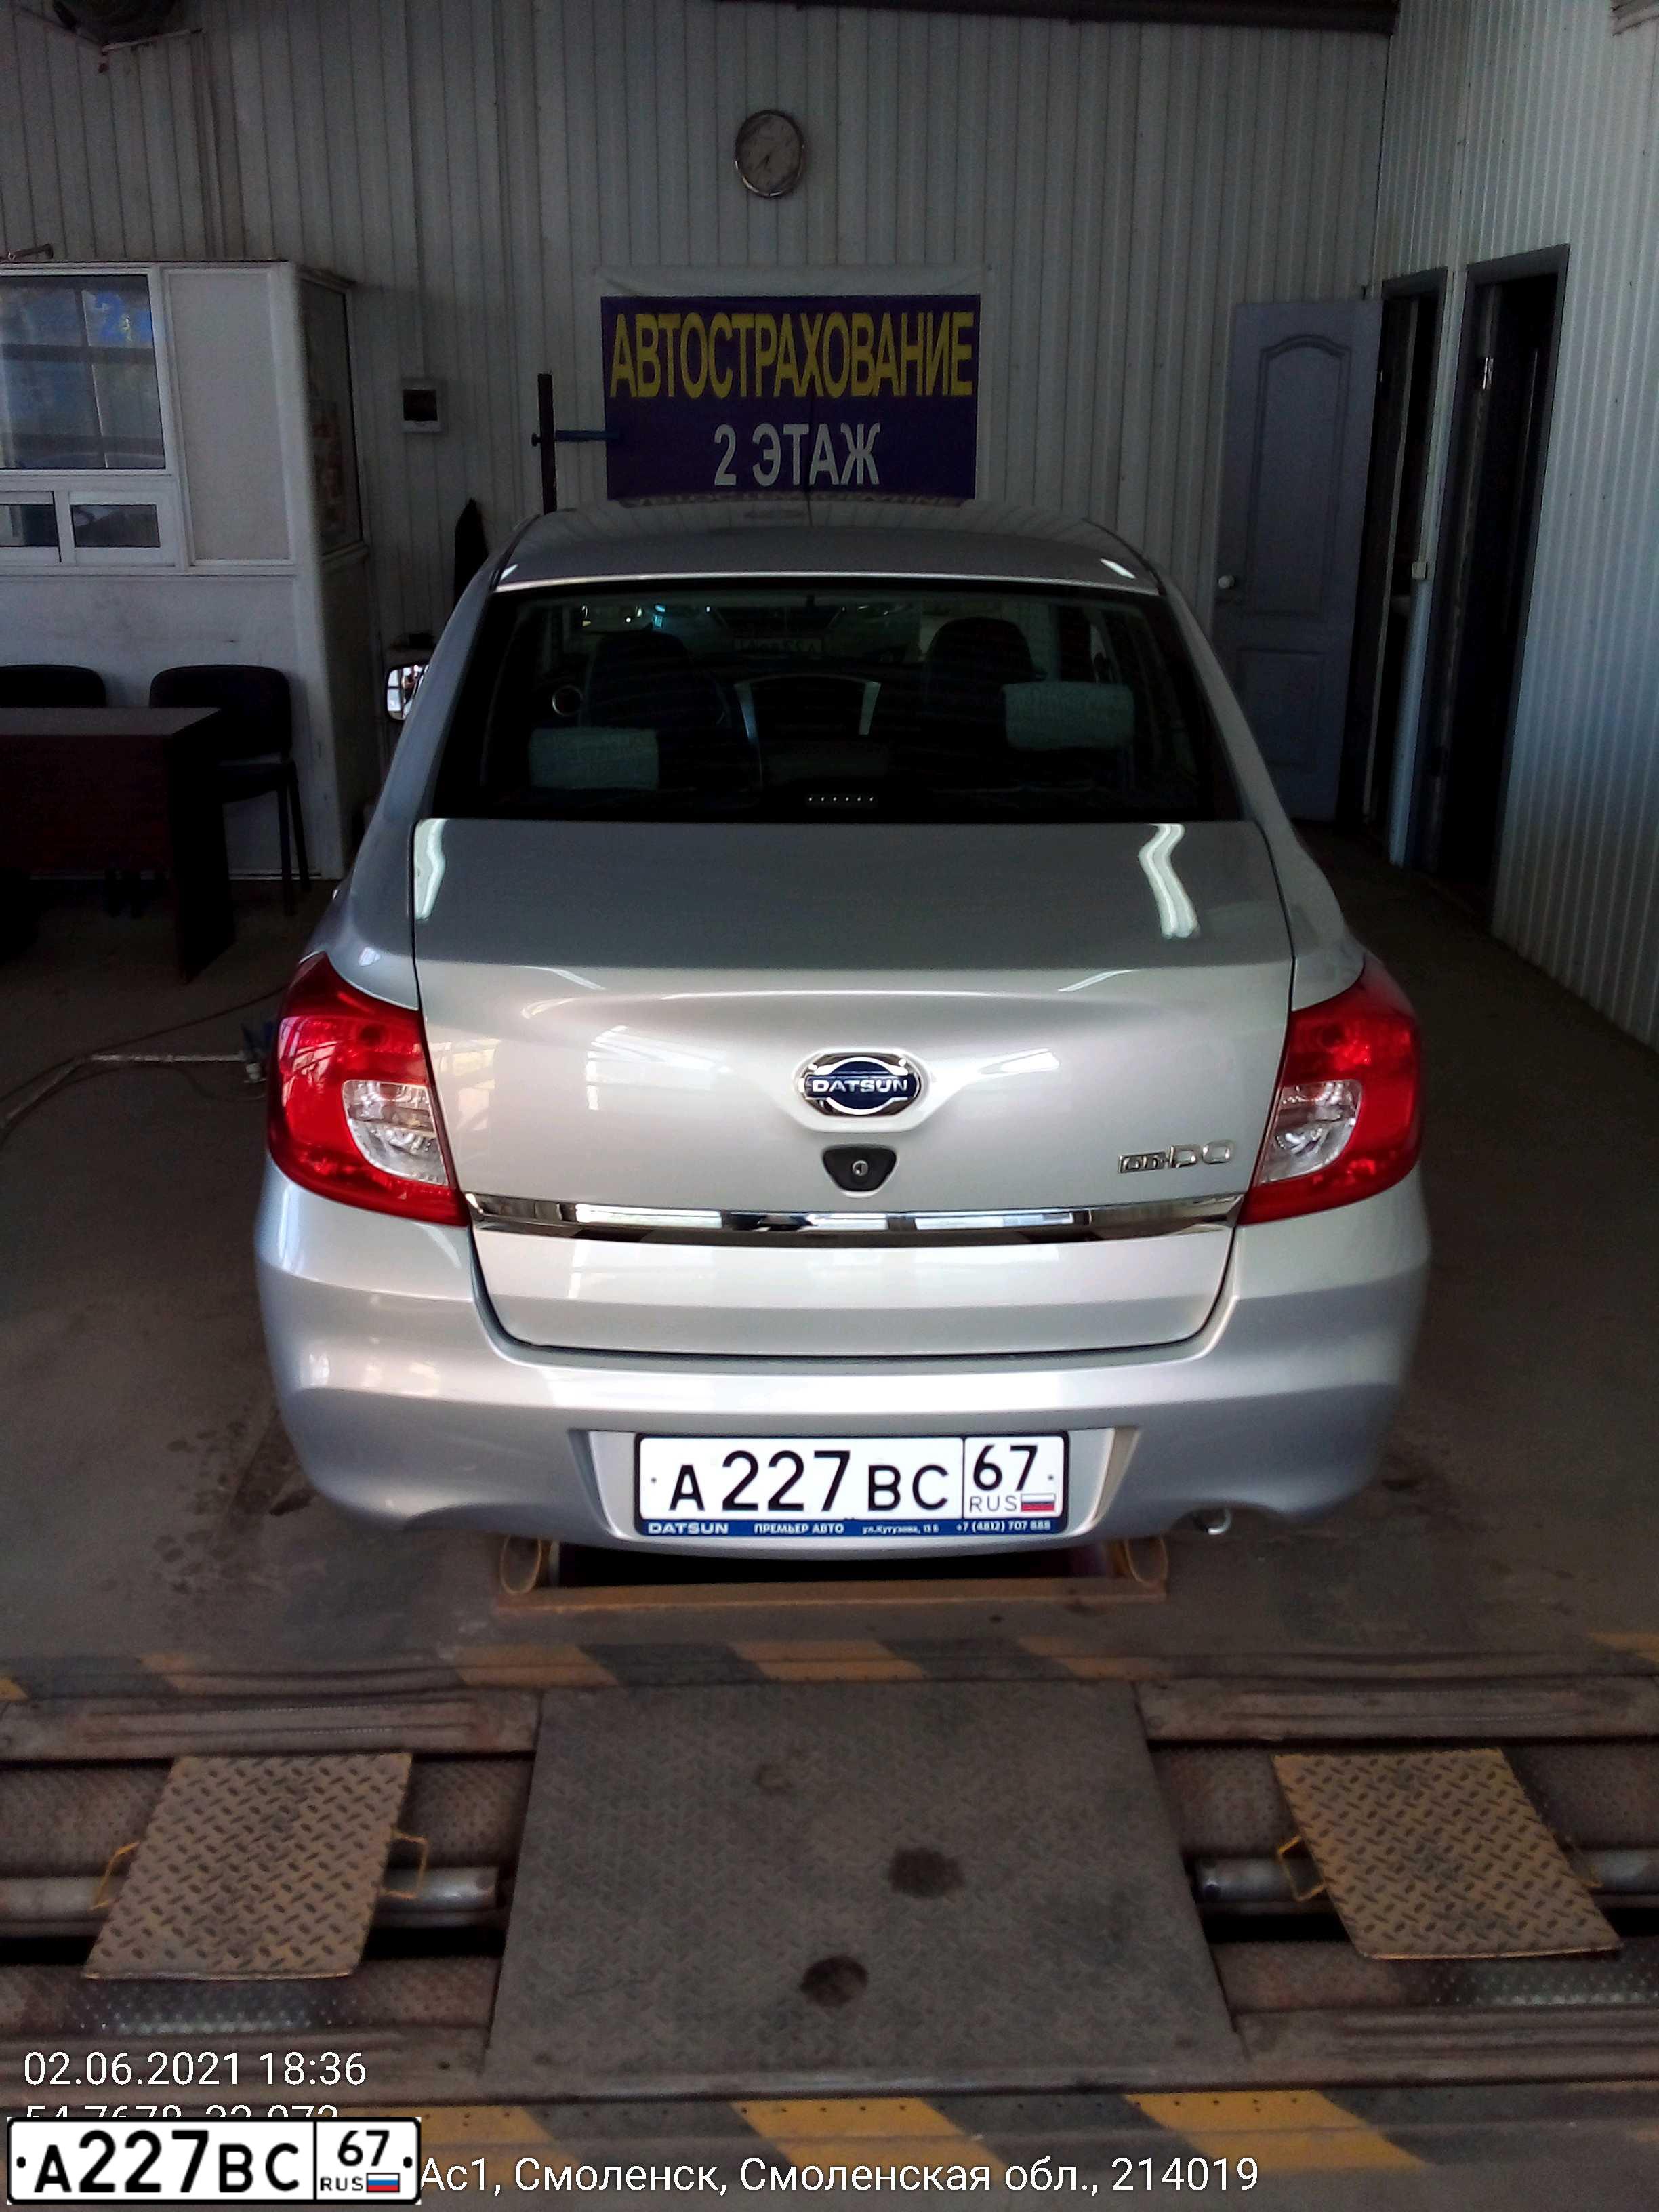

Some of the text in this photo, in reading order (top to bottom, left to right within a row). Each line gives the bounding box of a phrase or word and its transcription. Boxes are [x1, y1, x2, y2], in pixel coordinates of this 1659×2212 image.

[609, 312, 975, 398] АВТОСТРАХОВАНИЕ
[714, 423, 880, 487] 2 ЭТАЖ
[812, 1078, 908, 1093] DATSUN
[972, 1444, 1039, 1492] 67
[969, 1495, 1017, 1513] RUS
[647, 1521, 729, 1534] DATSUN
[754, 1522, 845, 1534] ПРЕМЬЕР АВТО
